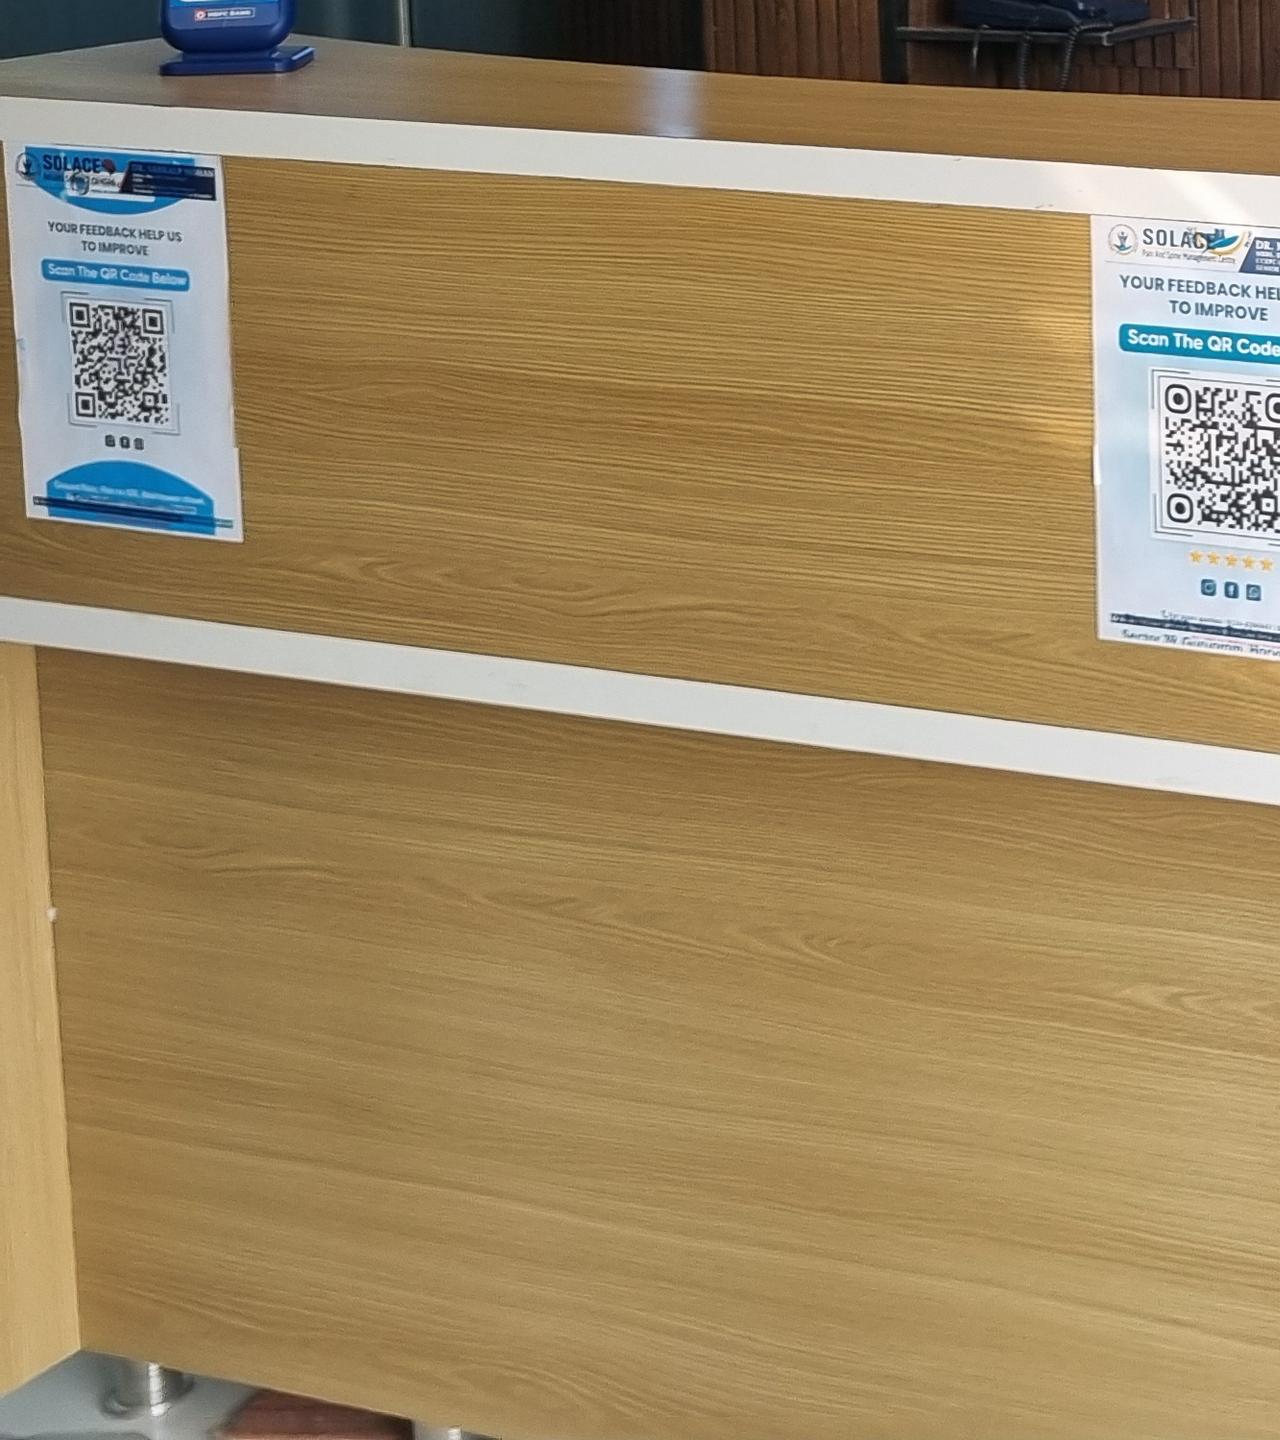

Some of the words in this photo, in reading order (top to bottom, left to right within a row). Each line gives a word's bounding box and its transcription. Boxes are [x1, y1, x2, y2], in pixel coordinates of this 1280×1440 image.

[43, 154, 102, 174] SOLACE
[47, 220, 78, 234] YOUR
[79, 224, 137, 239] FEEDBACK
[138, 229, 166, 241] HELP
[166, 231, 183, 242] US
[81, 240, 96, 252] TO
[98, 242, 149, 256] IMPROVE
[1255, 240, 1274, 250] DR.
[48, 263, 75, 276] Scan
[77, 265, 98, 278] The
[100, 268, 117, 280] QR
[120, 269, 149, 283] Code
[152, 272, 187, 285] Below
[1119, 274, 1165, 292] YOUR
[1167, 279, 1251, 299] FEEDBACK
[1169, 300, 1191, 315] TO
[1195, 302, 1269, 321] IMPROVE
[1128, 329, 1169, 347] Scan
[1172, 332, 1204, 350] The
[1207, 335, 1233, 353] QR
